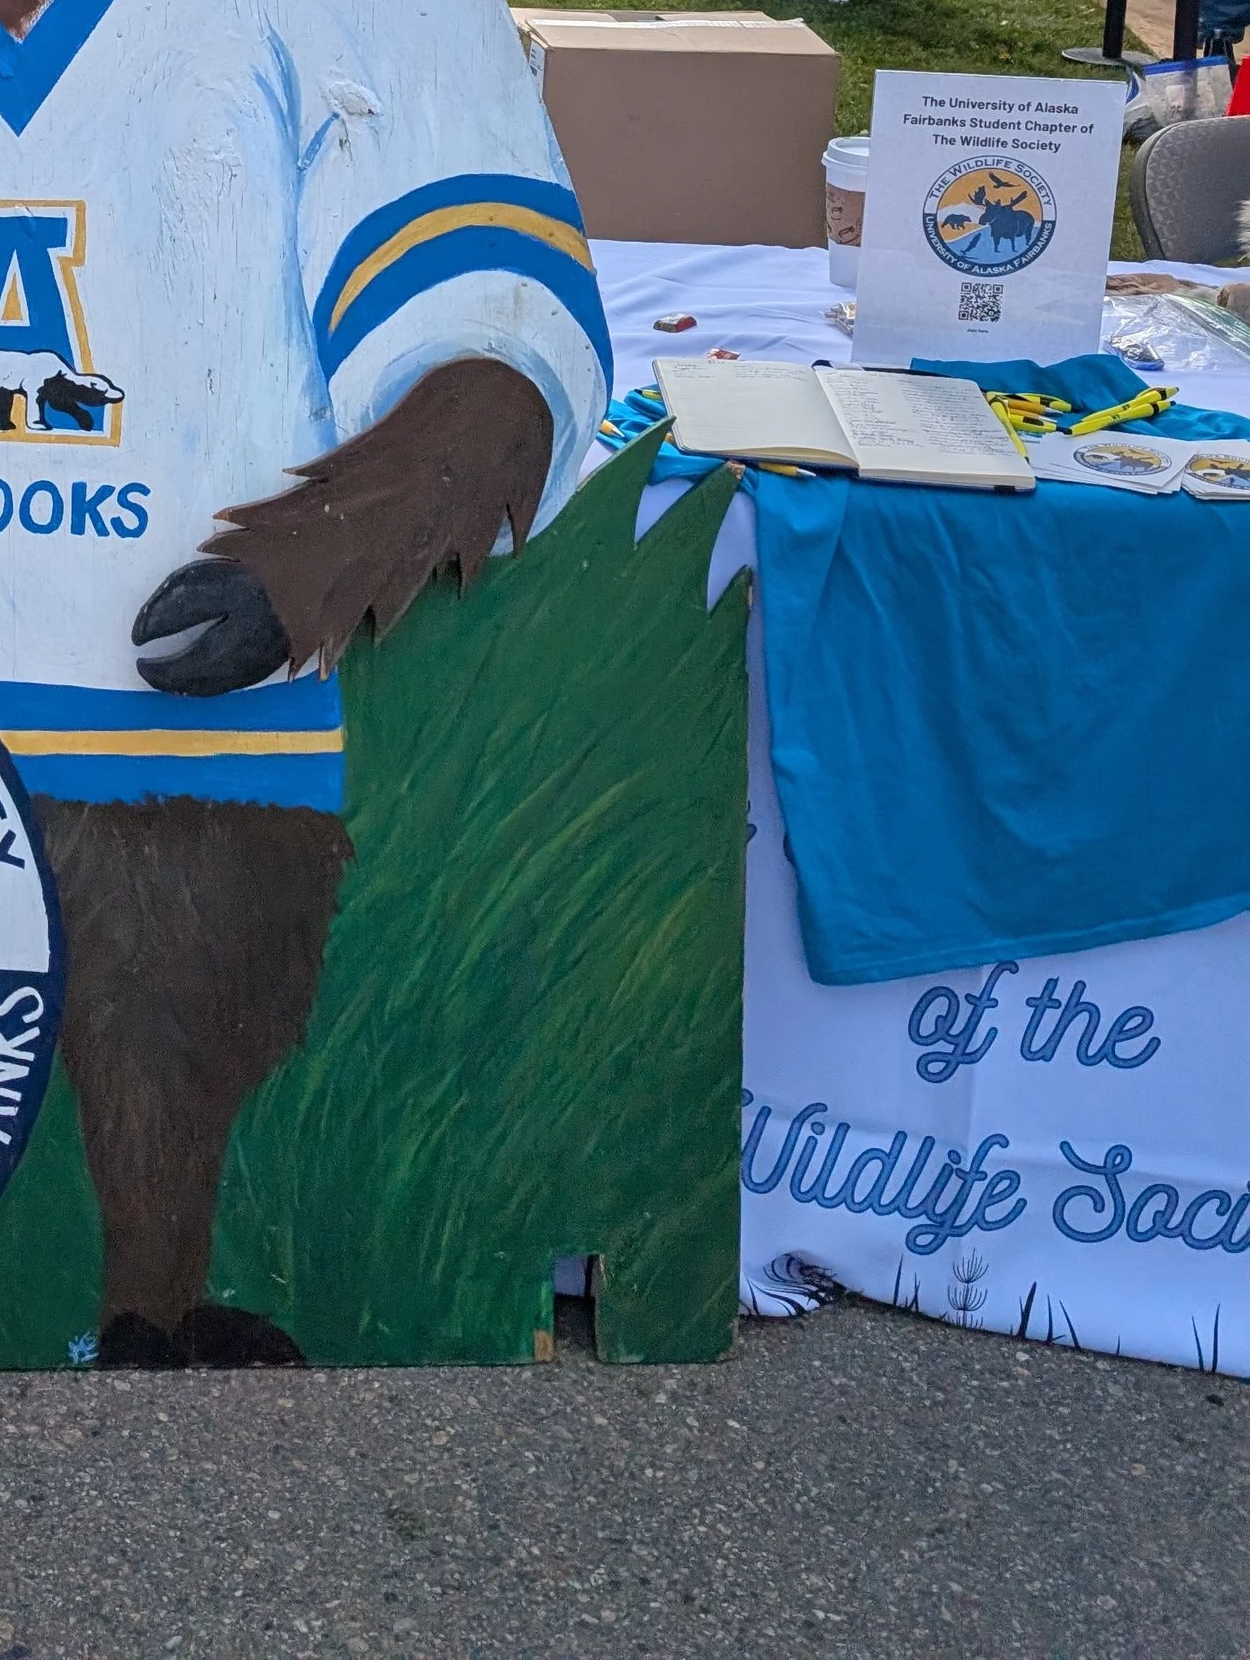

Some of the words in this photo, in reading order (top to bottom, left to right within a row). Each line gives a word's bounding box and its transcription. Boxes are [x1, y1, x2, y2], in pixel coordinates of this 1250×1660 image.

[922, 96, 946, 107] The
[949, 97, 1015, 113] University
[1017, 101, 1032, 112] of
[1034, 102, 1079, 114] Alaska
[903, 114, 966, 127] Fairbanks
[969, 117, 1022, 130] Student
[1024, 120, 1077, 134] Chapter
[1080, 123, 1095, 134] of
[932, 134, 957, 145] The
[960, 135, 1008, 148] Wildlife
[1011, 138, 1062, 153] Society
[930, 176, 950, 199] THE
[948, 158, 1013, 177] WILDLIFE
[1014, 163, 1053, 206] SOCIETY
[925, 216, 958, 264] UNIVERSITY
[957, 261, 972, 271] OF
[970, 264, 1014, 275] ALASKA
[1012, 222, 1053, 268] FAIRBANKS
[907, 960, 1019, 1083] of
[1019, 976, 1161, 1069] the
